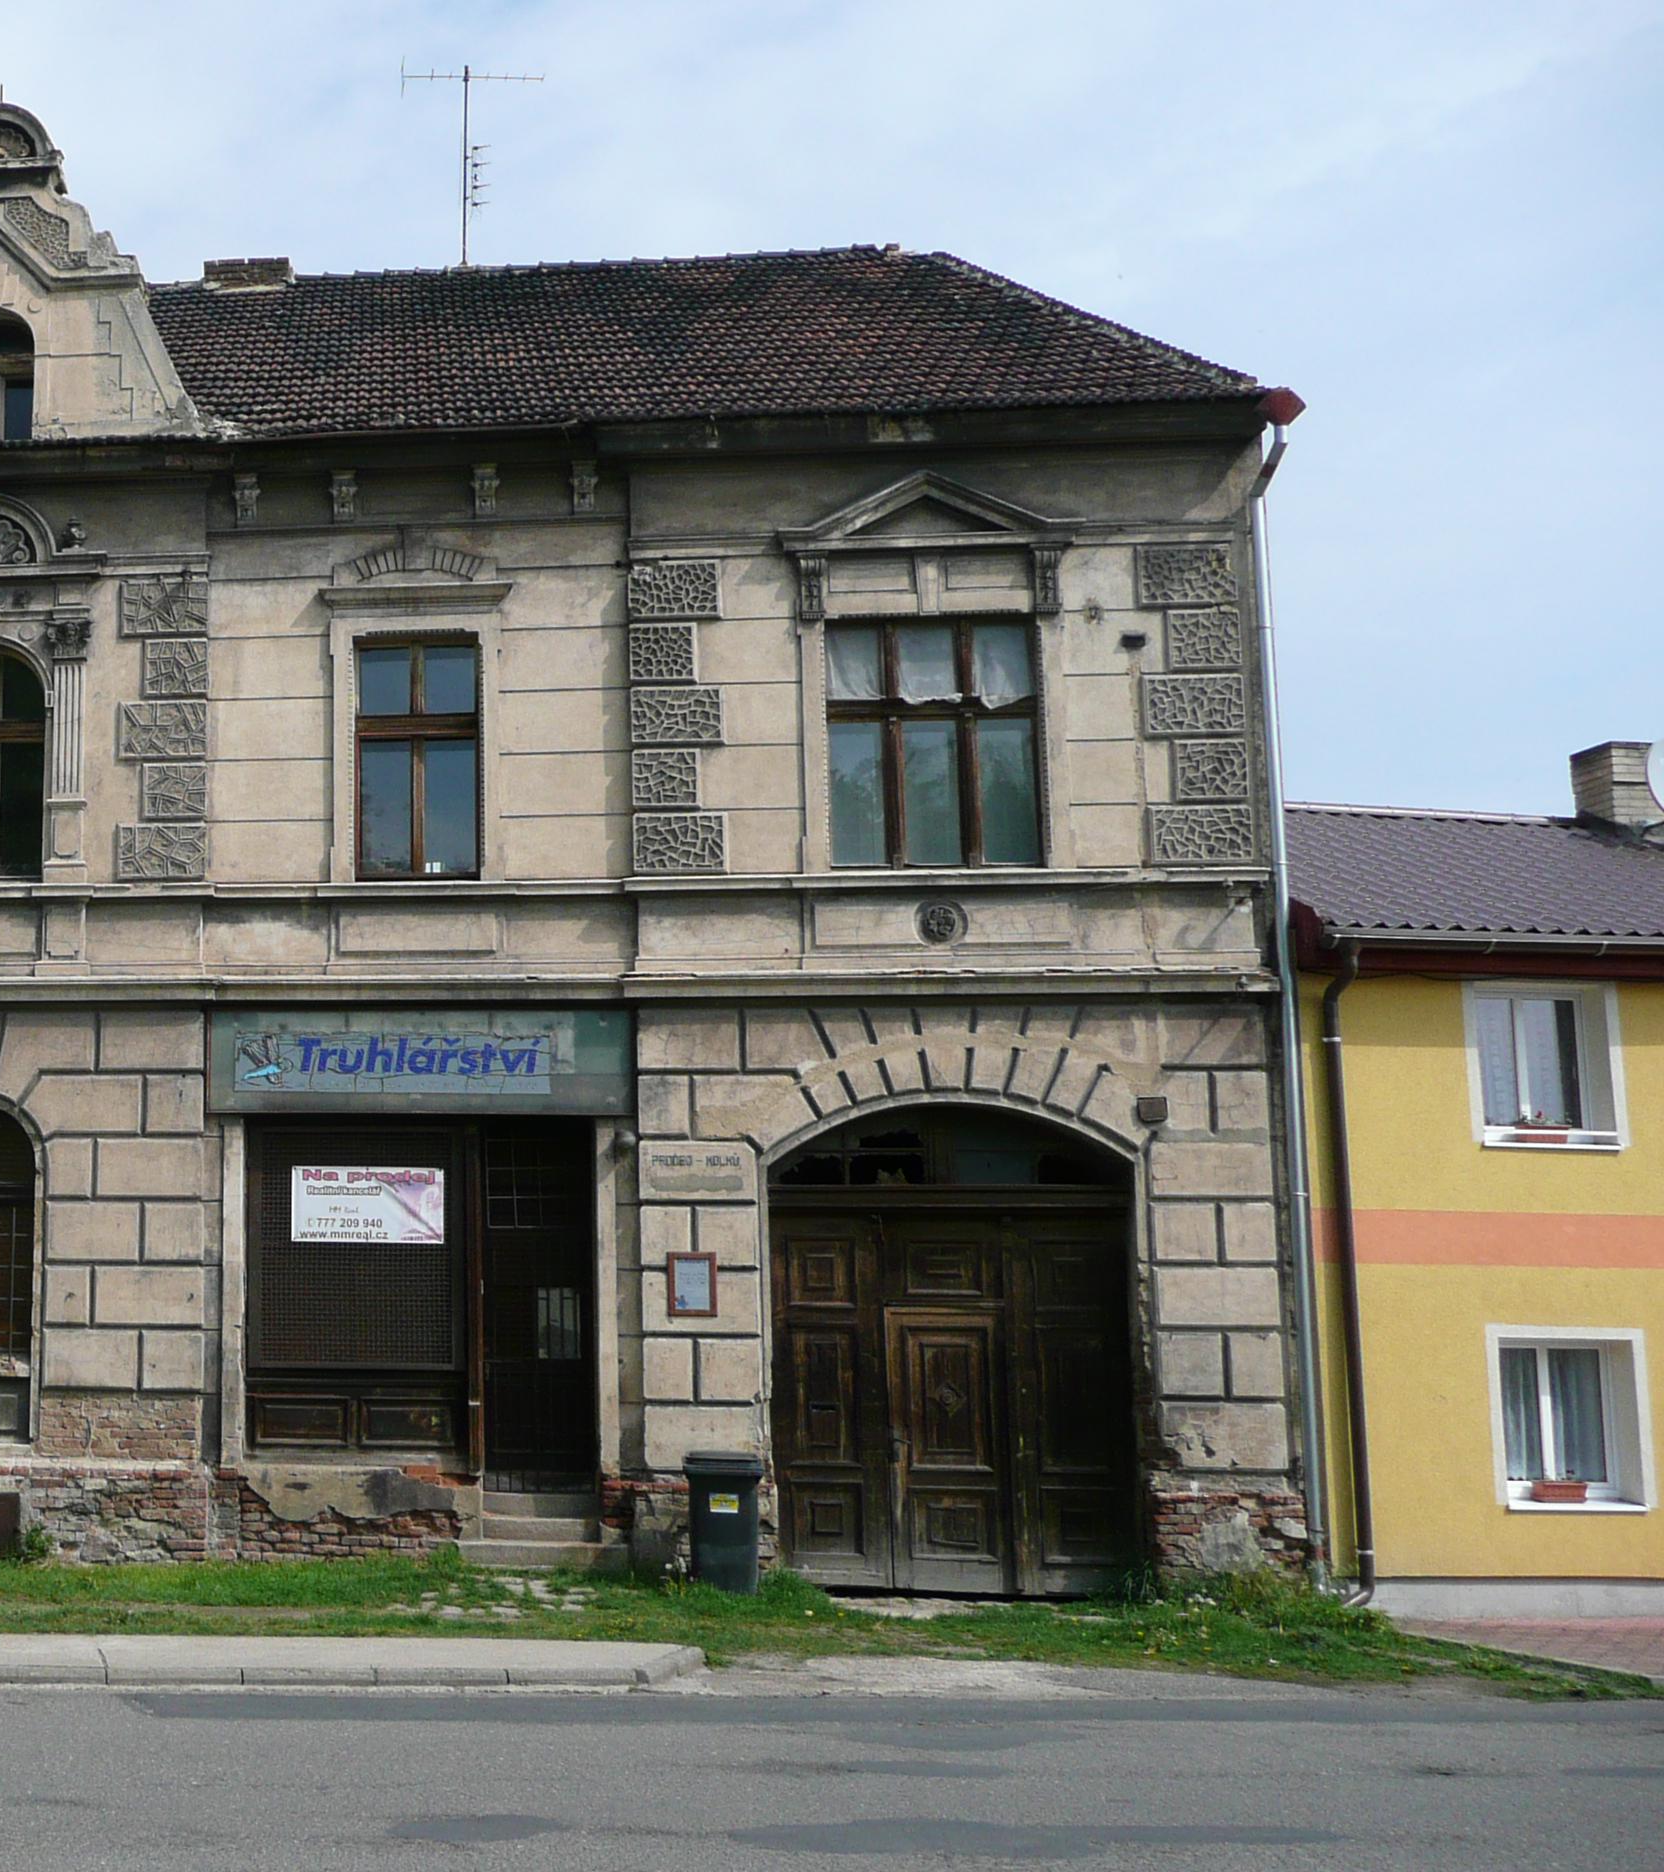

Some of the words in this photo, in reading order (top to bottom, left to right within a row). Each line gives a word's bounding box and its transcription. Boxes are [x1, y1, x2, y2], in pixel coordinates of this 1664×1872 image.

[297, 1036, 540, 1074] Truhlářství
[302, 1169, 339, 1181] Na
[347, 1170, 435, 1185] prodej
[317, 1217, 336, 1228] 777
[339, 1218, 359, 1228] 209
[362, 1218, 383, 1228] 940
[299, 1229, 388, 1240] www.mmreal.cz
